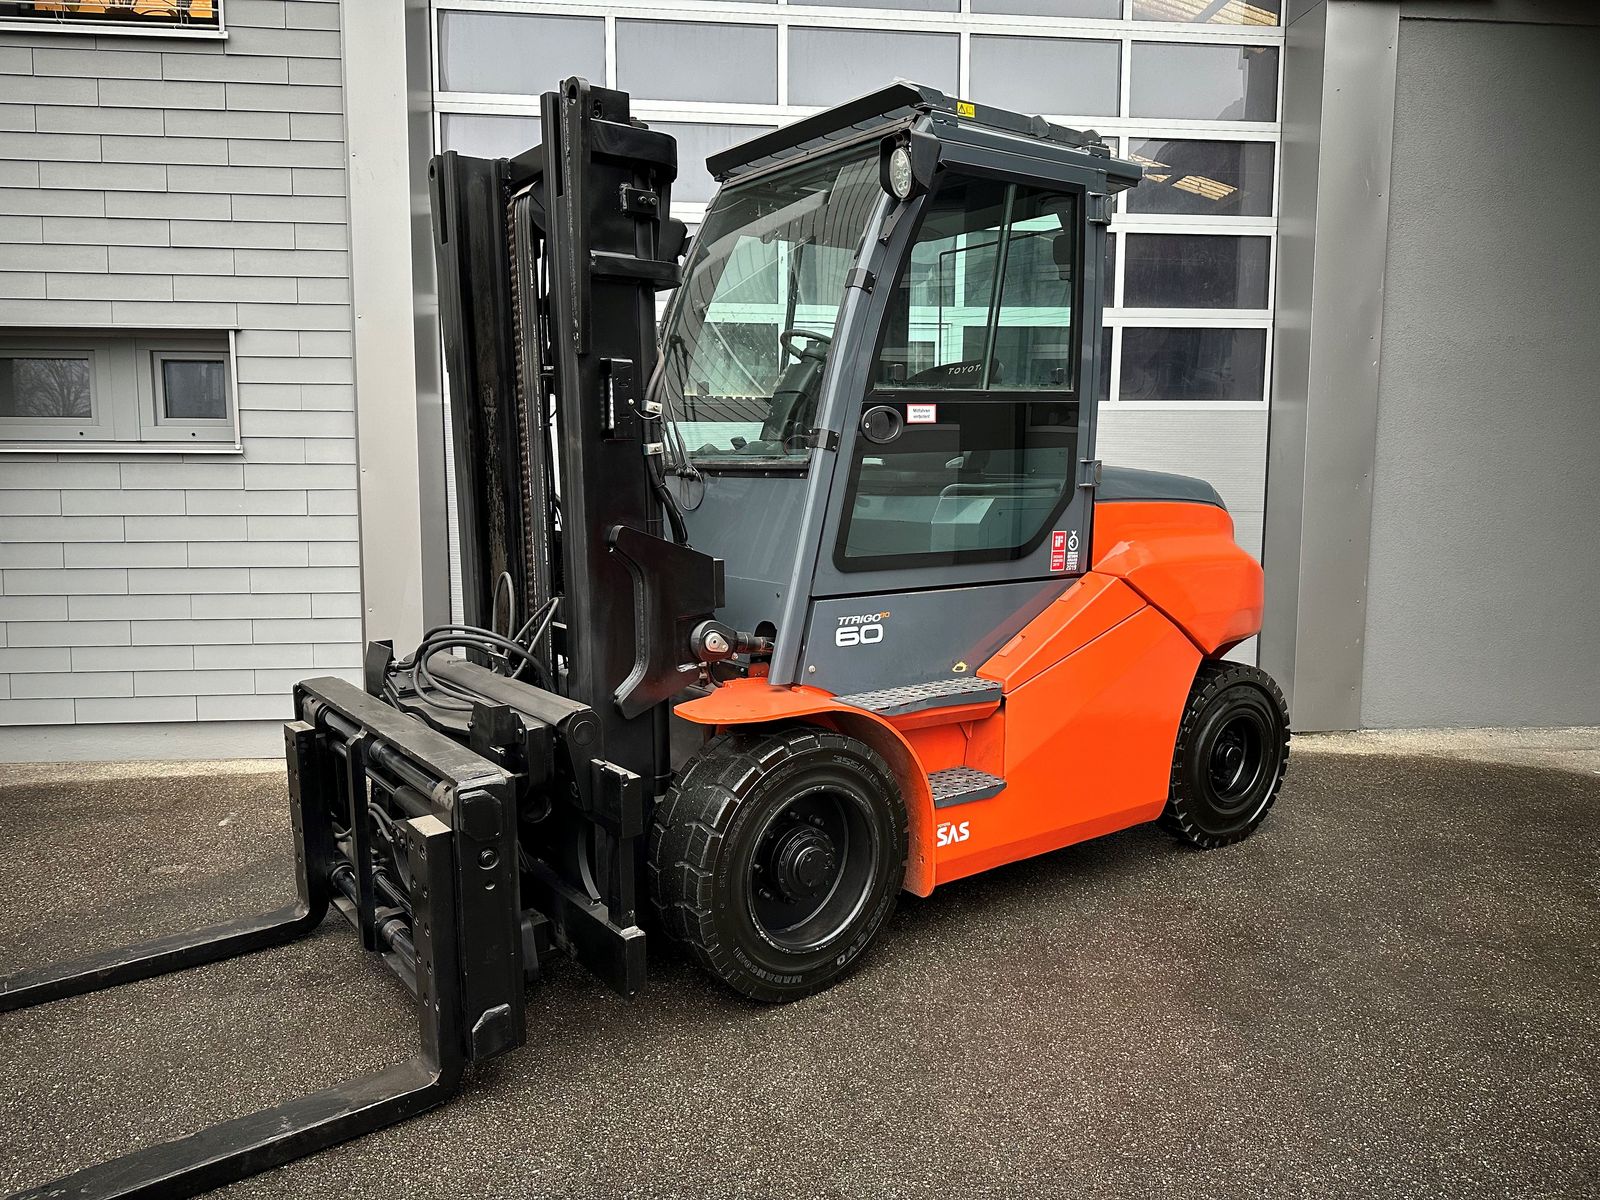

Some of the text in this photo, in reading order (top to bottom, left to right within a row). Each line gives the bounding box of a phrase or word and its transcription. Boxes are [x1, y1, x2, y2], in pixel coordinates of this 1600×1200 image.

[948, 363, 982, 375] TOYOT
[835, 624, 884, 647] 60
[936, 821, 970, 848] SAS
